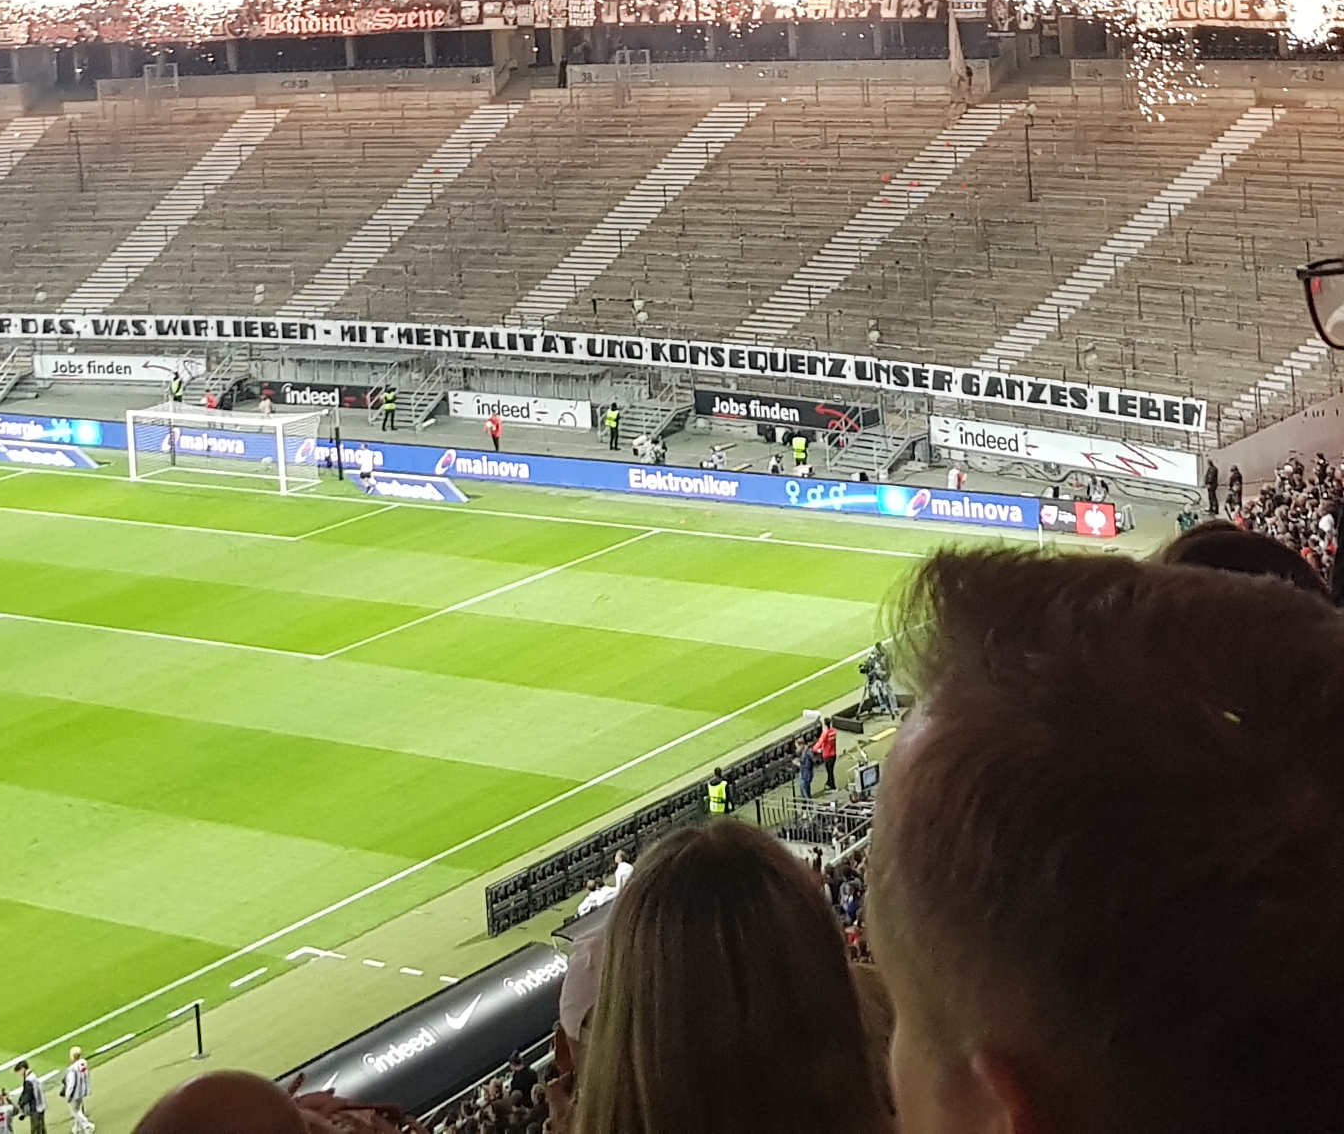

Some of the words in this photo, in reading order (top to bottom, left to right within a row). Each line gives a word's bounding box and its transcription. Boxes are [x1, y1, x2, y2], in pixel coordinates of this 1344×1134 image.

[52, 359, 84, 376] Jobs
[86, 360, 132, 375] finden
[92, 319, 148, 336] WAS
[155, 319, 209, 337] WIR
[216, 320, 317, 340] LIEBEN
[341, 325, 390, 344] MIT
[586, 338, 643, 359] UND
[651, 342, 847, 378] KONSEQUENZ
[854, 361, 953, 393] UNSER
[961, 372, 1089, 410] GANZES
[1097, 391, 1203, 427] LEBEN
[284, 383, 340, 406] indeed
[475, 397, 531, 420] indeed
[712, 396, 748, 418] Jobs
[749, 398, 800, 424] finden
[959, 425, 1020, 453] indeed
[456, 454, 531, 480] mainova
[628, 467, 740, 497] Elektroniker
[931, 498, 1024, 524] mainova
[503, 952, 569, 998] indeed
[367, 1026, 438, 1074] indeed
